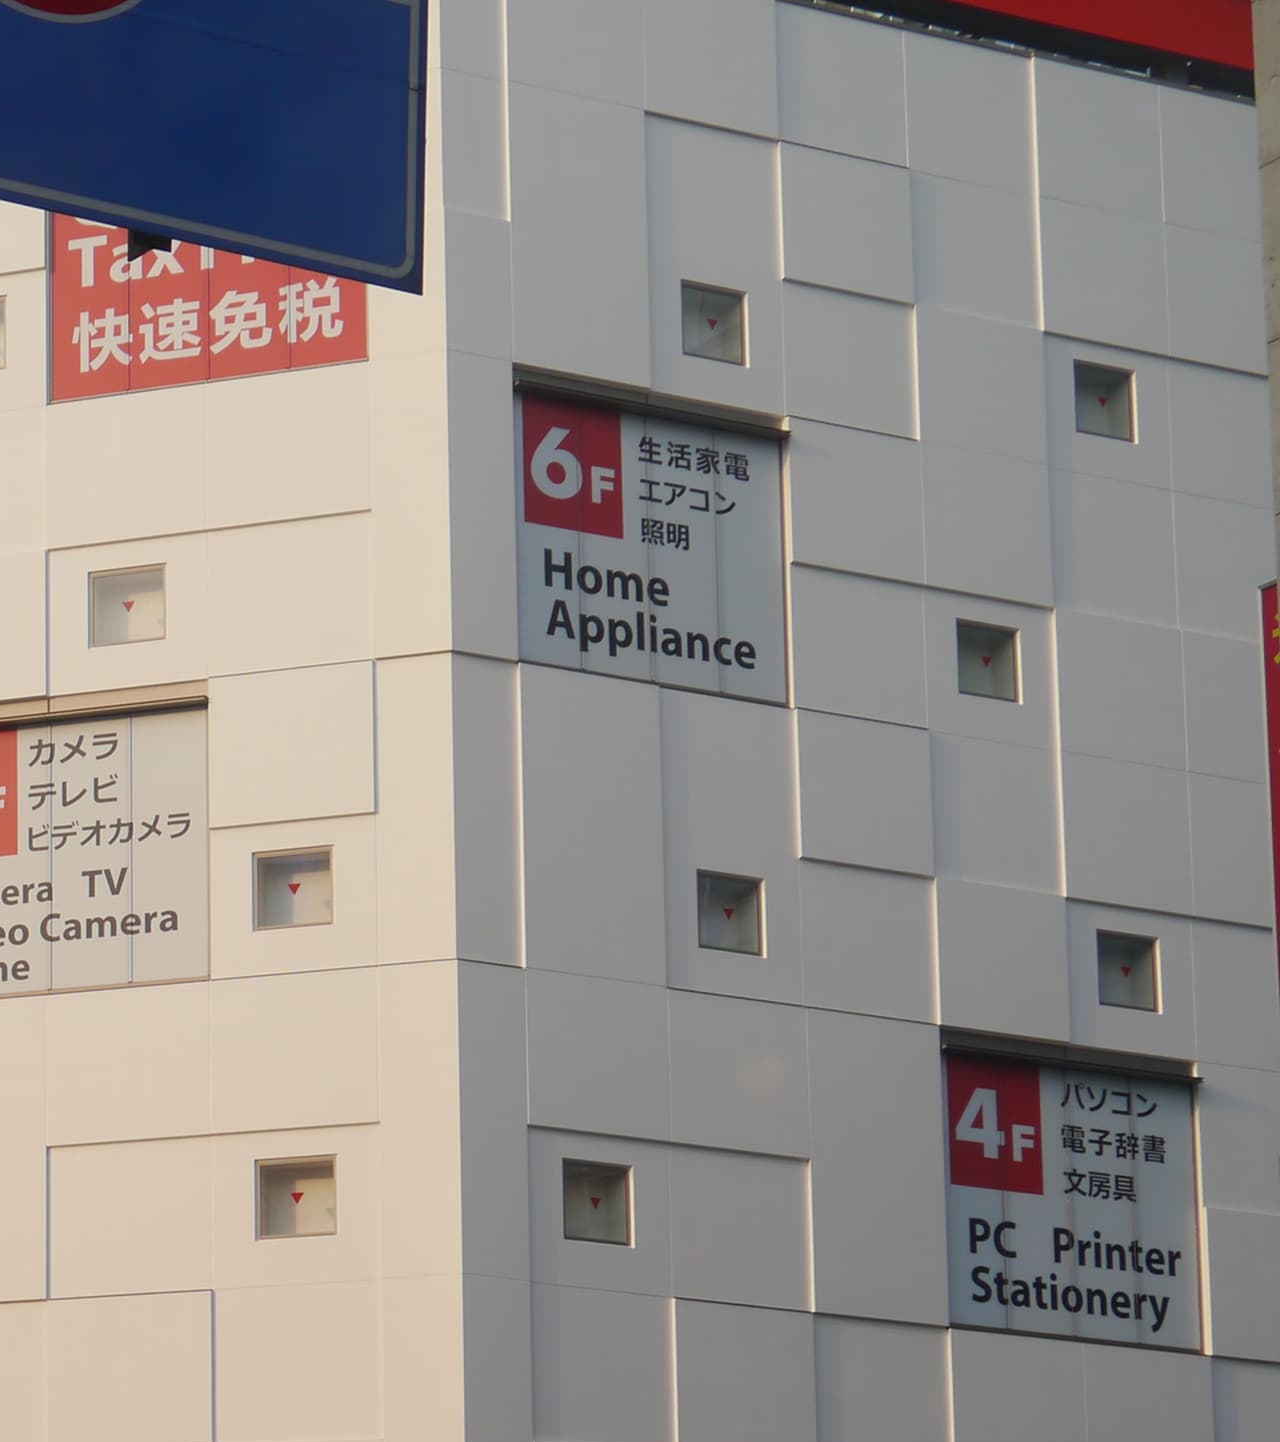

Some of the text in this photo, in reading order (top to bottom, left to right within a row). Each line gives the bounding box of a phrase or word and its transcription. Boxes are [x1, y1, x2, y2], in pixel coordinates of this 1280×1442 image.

[68, 235, 185, 288] Tax
[71, 276, 345, 374] 快速免税
[531, 426, 616, 504] 6F
[638, 435, 750, 482] 生活家電
[638, 478, 737, 516] エアコン
[641, 517, 691, 551] 照明
[543, 547, 670, 607] Home
[546, 599, 757, 669] Appliance
[28, 732, 119, 767] カメラ
[28, 773, 119, 811] テレビ
[28, 812, 191, 852] ビデオカメラ
[81, 867, 128, 898] TV
[40, 909, 179, 942] Camera
[1060, 1083, 1158, 1118] パソコン
[955, 1087, 1036, 1163] 4F
[1060, 1124, 1167, 1165] 電子辞書
[1063, 1168, 1137, 1203] 文房具
[968, 1217, 1182, 1277] PC Printer
[971, 1266, 1170, 1333] Stationery
